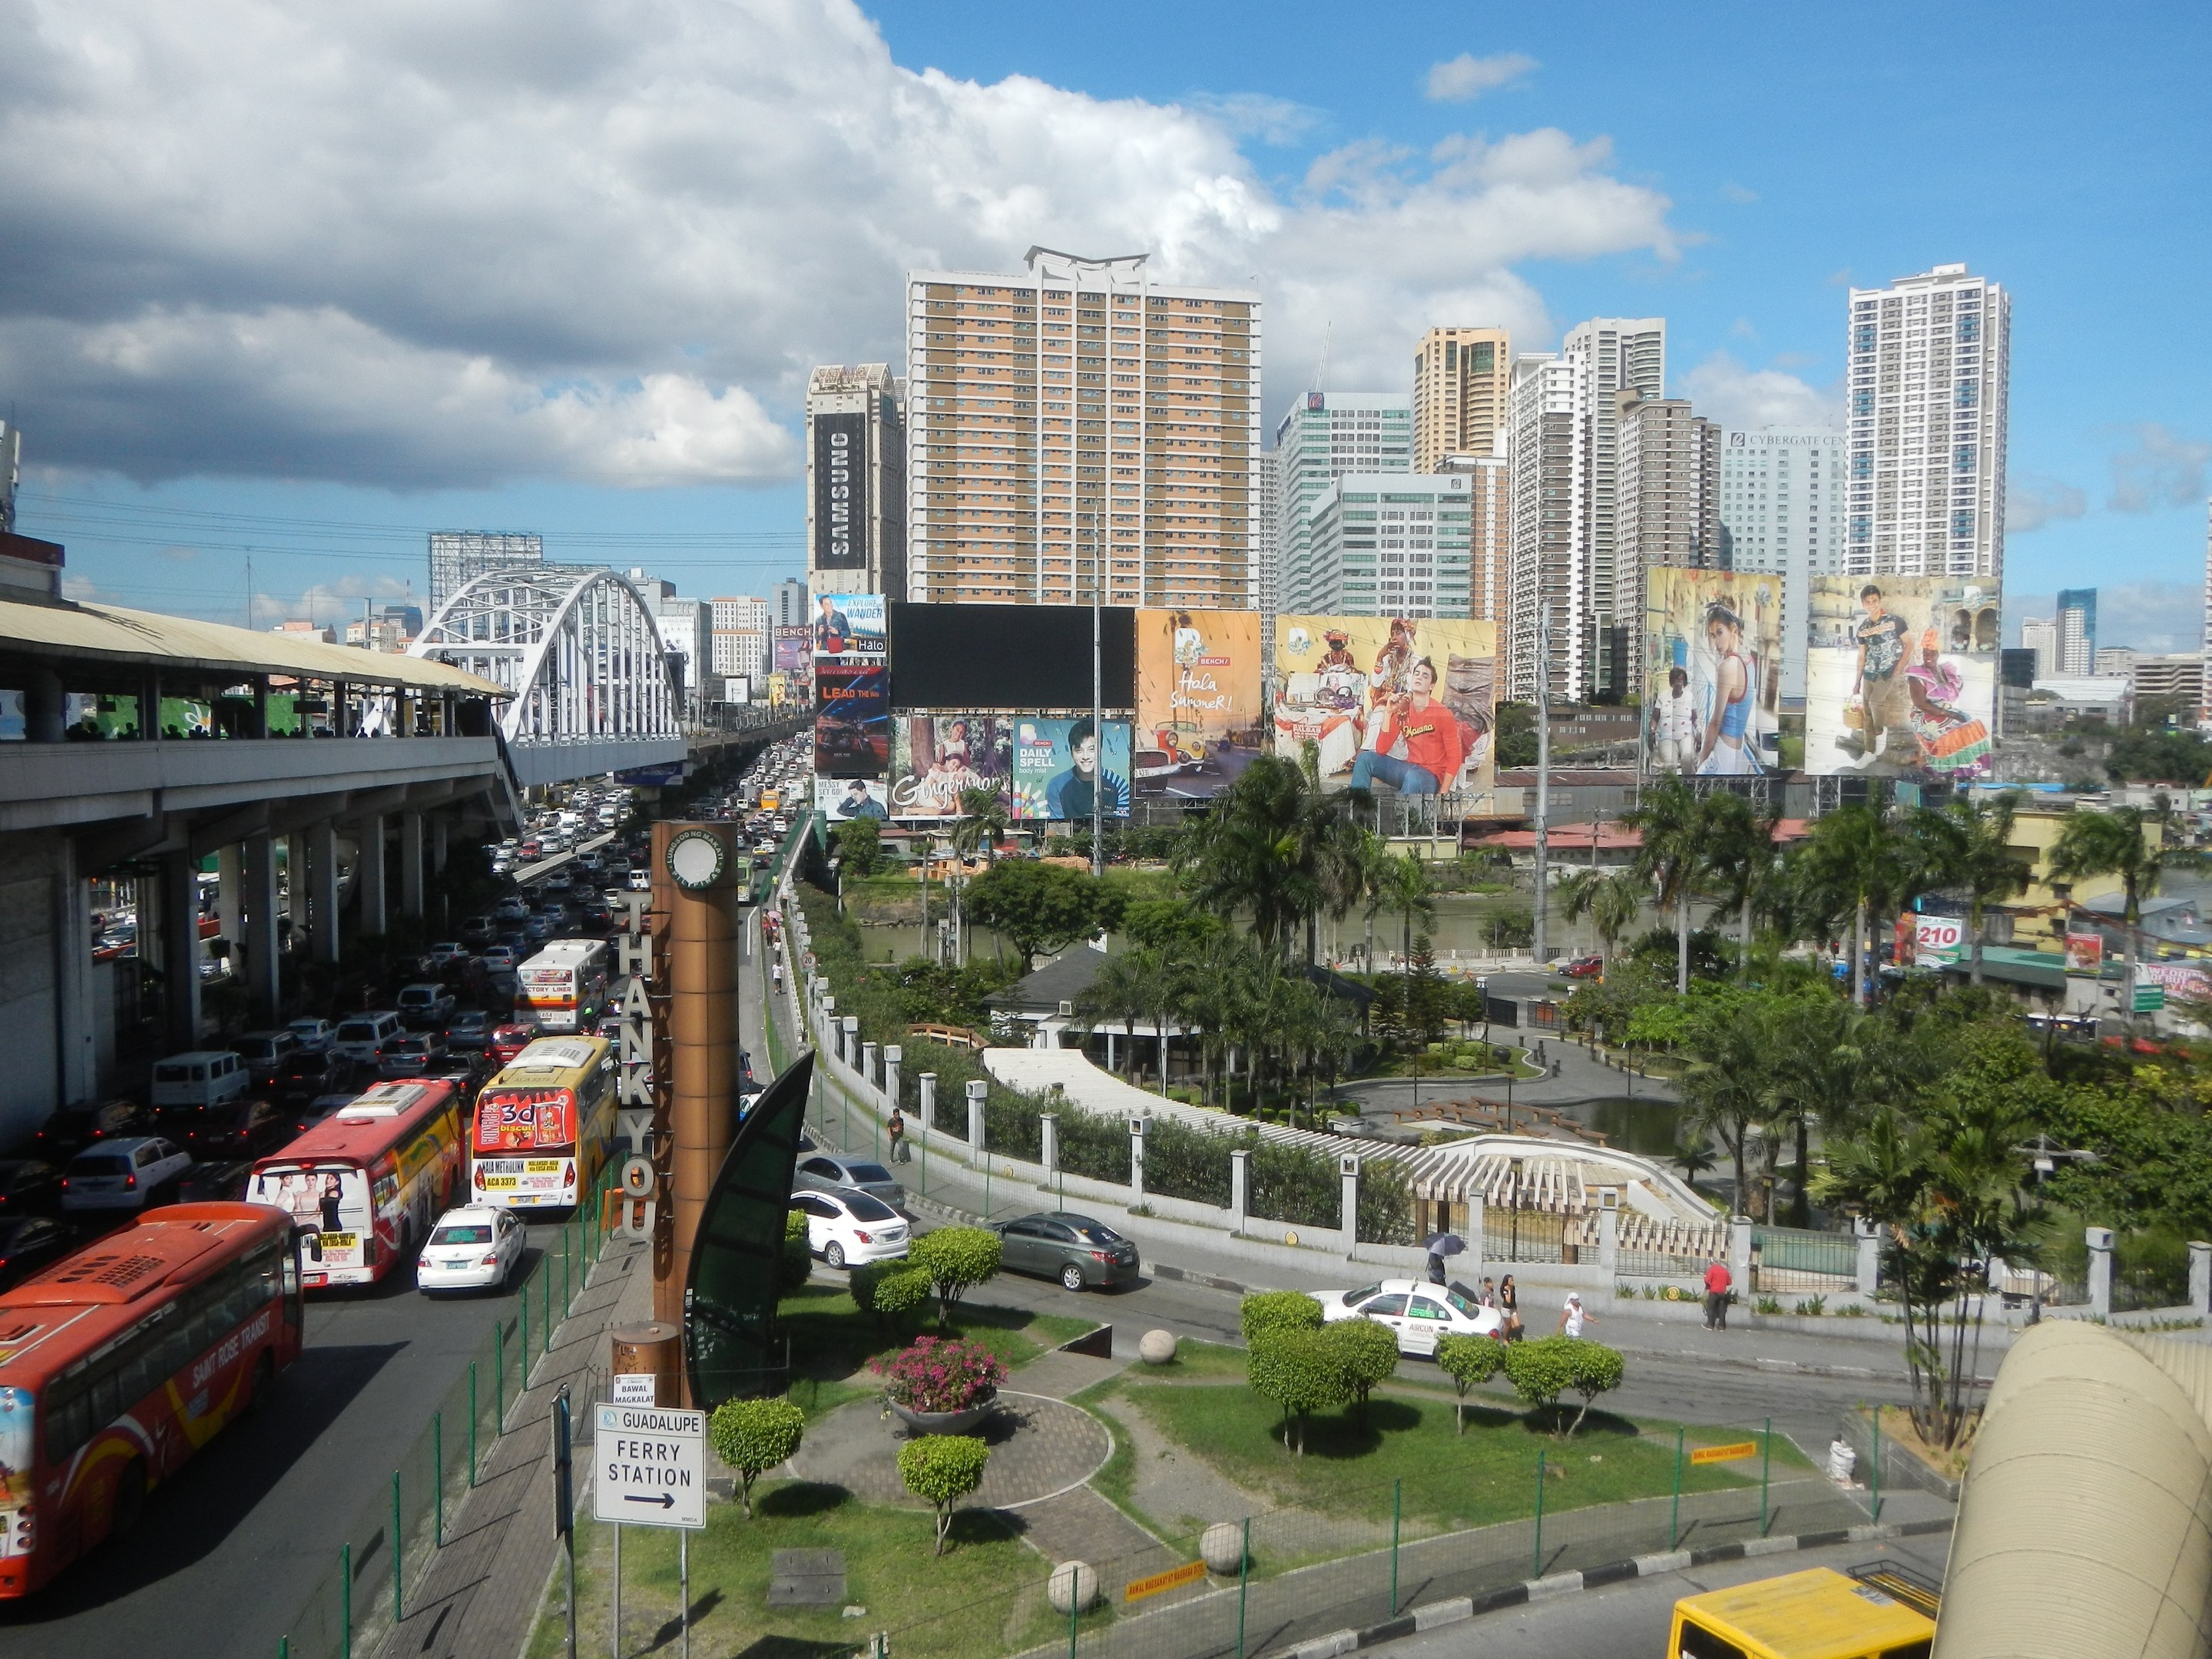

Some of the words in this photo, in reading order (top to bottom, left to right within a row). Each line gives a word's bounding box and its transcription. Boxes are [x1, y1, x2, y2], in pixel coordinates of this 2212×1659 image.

[1750, 435, 1820, 445] CYBERGATE
[831, 432, 849, 555] SAMSUNG
[848, 598, 877, 607] EXPLORE
[847, 608, 882, 619] WANDER
[1179, 670, 1217, 691] Hola
[823, 687, 855, 699] LEAD
[858, 690, 869, 698] THE
[1019, 748, 1052, 758] DAILY
[1019, 757, 1055, 767] SPELL
[667, 832, 690, 864] LUNGSOD
[702, 833, 724, 860] MAKATI
[1919, 926, 1957, 944] 210
[804, 956, 813, 965] 20
[2151, 974, 2187, 986] DEBUT
[617, 891, 655, 1106] THANK
[501, 1104, 535, 1124] 3d
[481, 1114, 499, 1144] PANDA
[482, 1161, 495, 1174] NAIA
[495, 1160, 525, 1174] METROLINK
[487, 1178, 500, 1187] ACA
[500, 1177, 516, 1187] 3373
[617, 1113, 656, 1241] YOU
[1409, 1323, 1434, 1333] AIRCON
[193, 1353, 217, 1389] SAINT
[218, 1334, 240, 1368] ROSE
[240, 1310, 271, 1350] TRANSIT
[614, 1396, 654, 1404] MAGKALAT
[623, 1412, 700, 1432] GUADALUPE
[618, 1439, 680, 1462] FERRY
[608, 1463, 690, 1487] STATION
